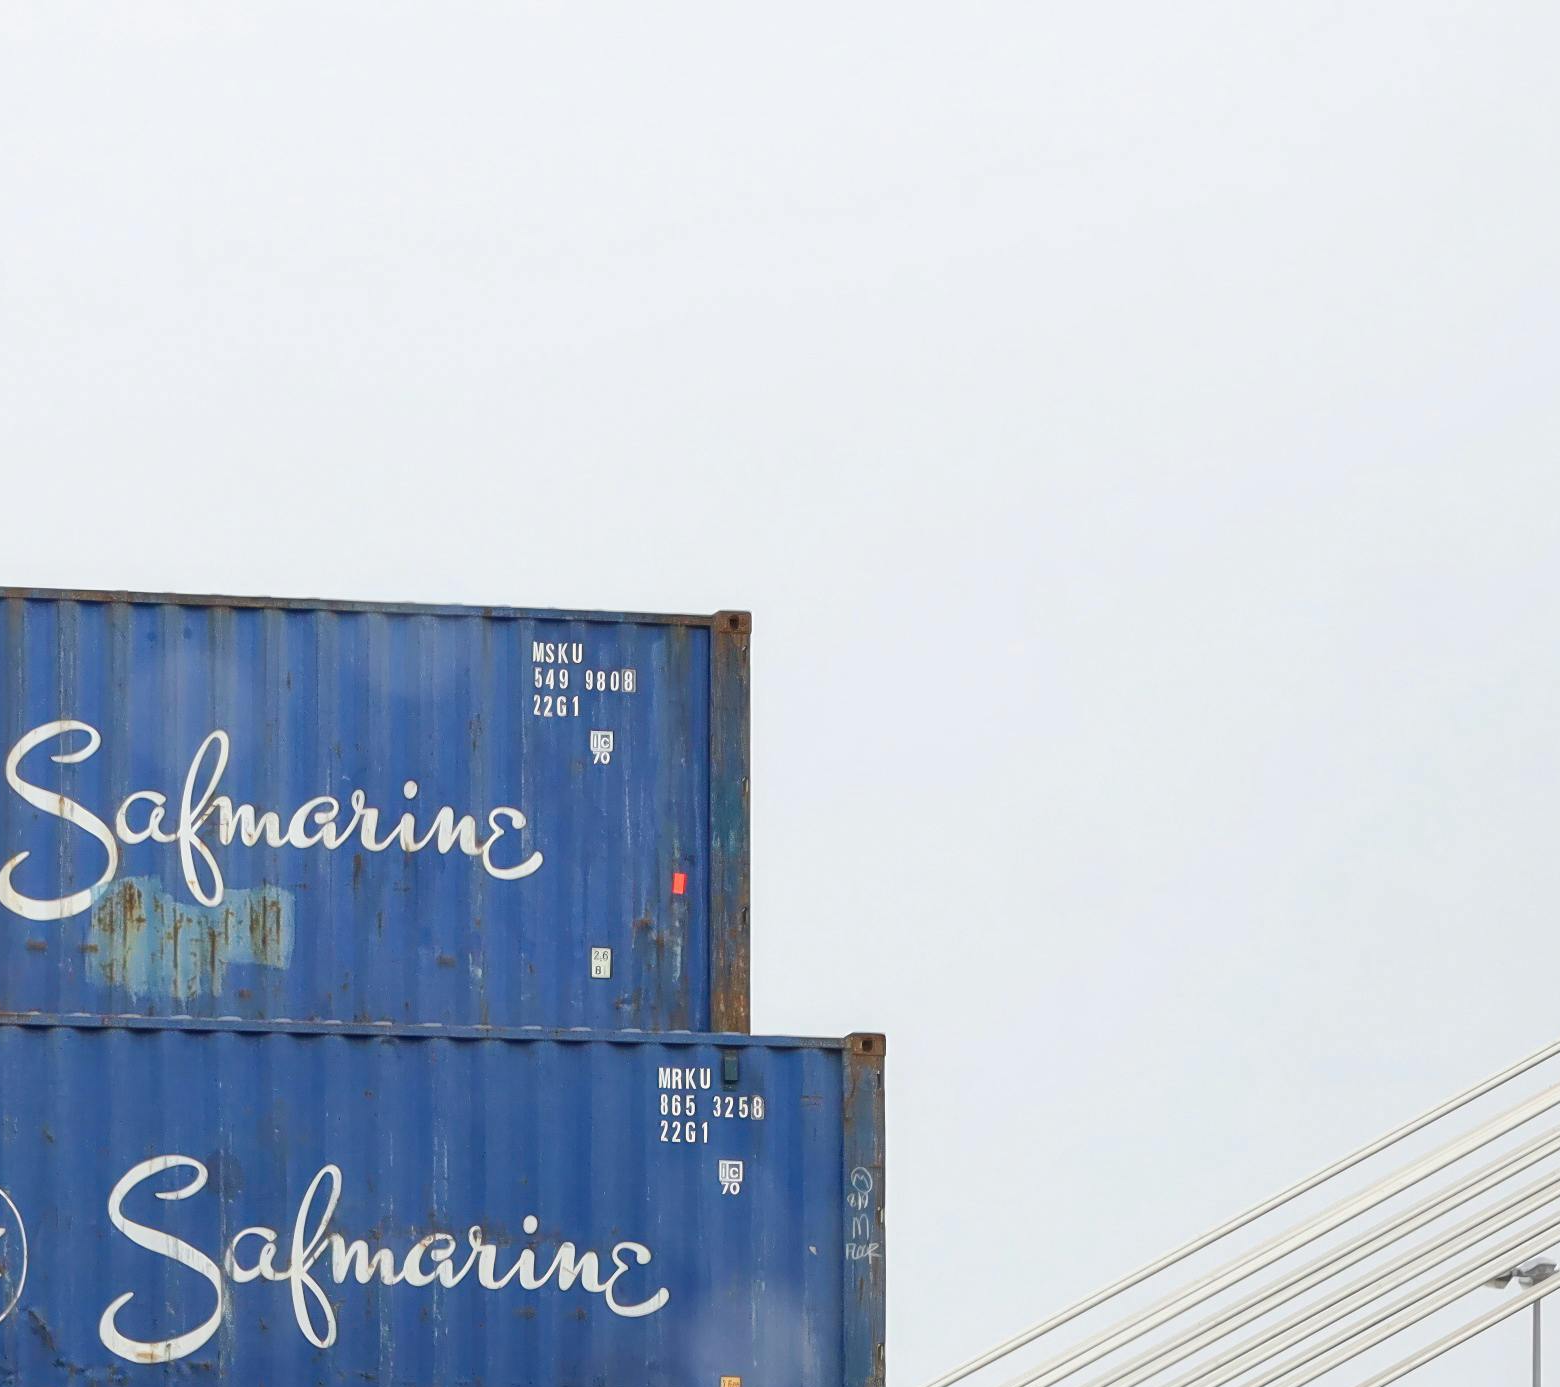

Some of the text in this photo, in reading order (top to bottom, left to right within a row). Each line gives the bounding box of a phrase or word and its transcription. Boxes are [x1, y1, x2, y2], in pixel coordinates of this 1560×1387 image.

[532, 641, 583, 664] MSKU
[533, 666, 569, 690] 549
[533, 694, 580, 717] 22G1
[592, 751, 611, 765] 70
[658, 1067, 712, 1090] MRKU
[660, 1093, 697, 1117] 865
[660, 1119, 709, 1144] 22G1
[721, 1181, 741, 1196] 70
[98, 1153, 670, 1364] Safmarine
